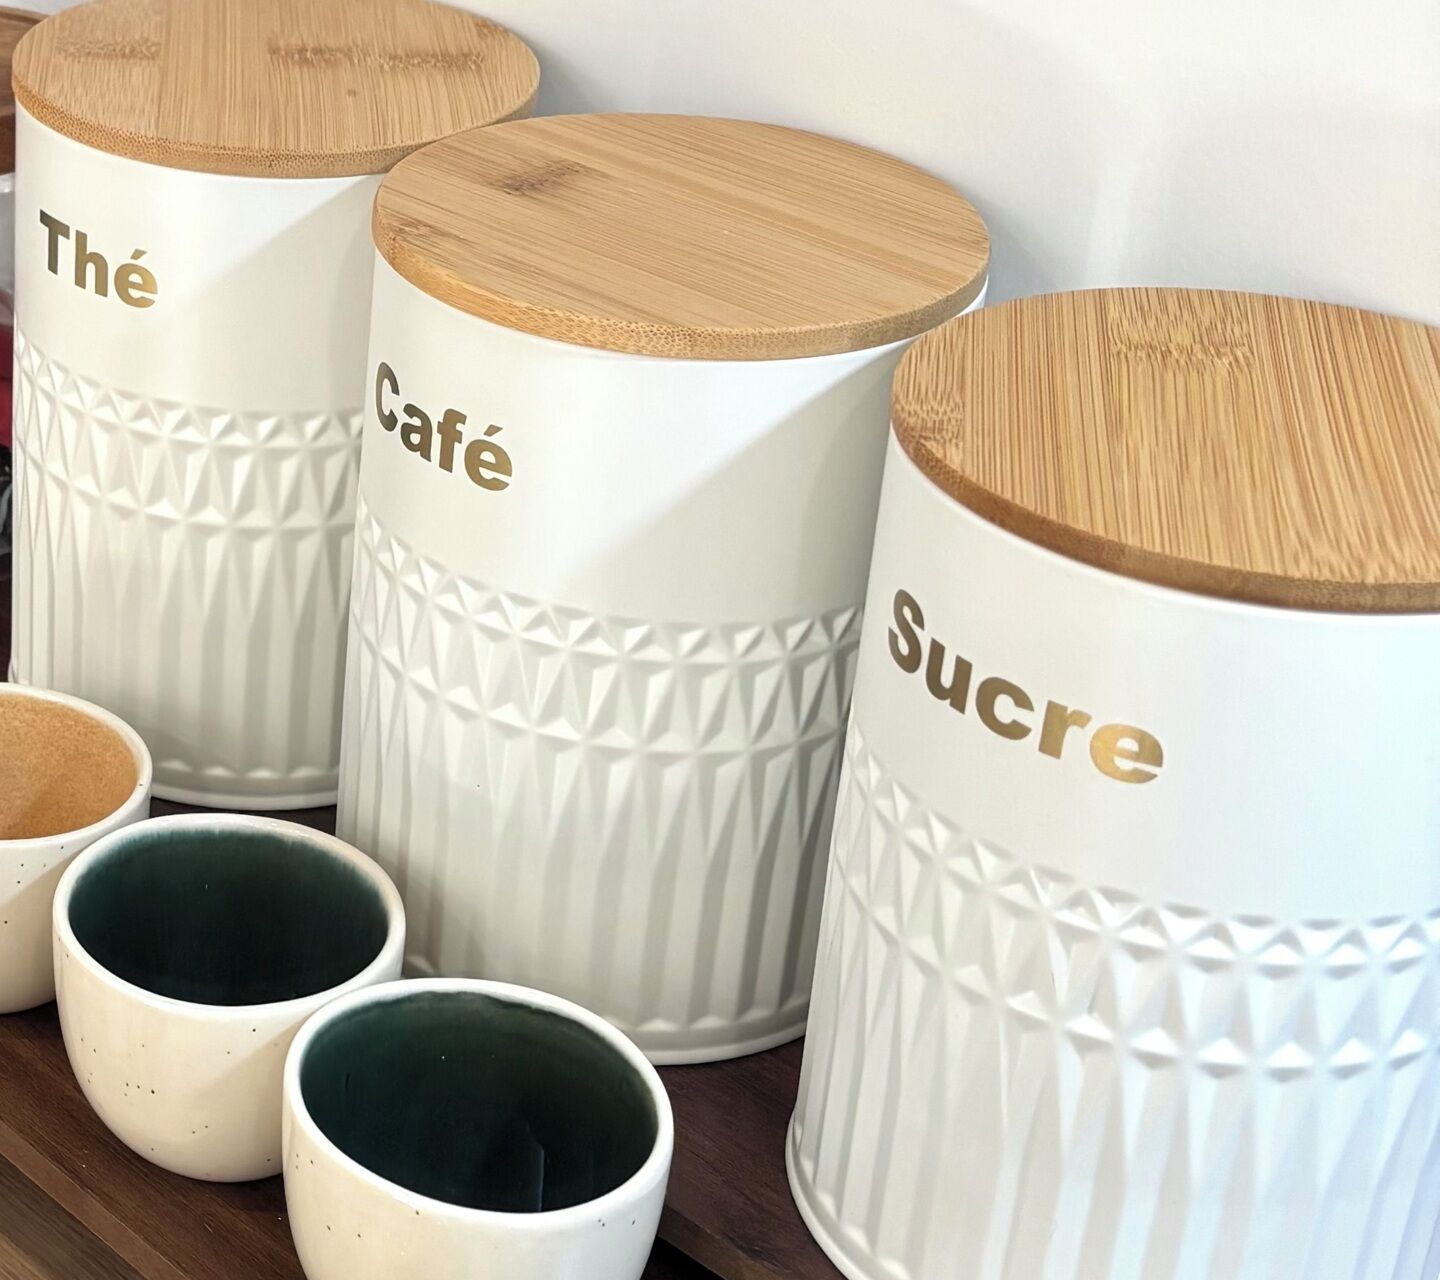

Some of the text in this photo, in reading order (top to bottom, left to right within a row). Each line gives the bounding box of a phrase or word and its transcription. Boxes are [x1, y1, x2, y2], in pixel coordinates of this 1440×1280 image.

[39, 208, 158, 308] Thé
[375, 361, 513, 491] Café
[888, 589, 1164, 784] Sucre
